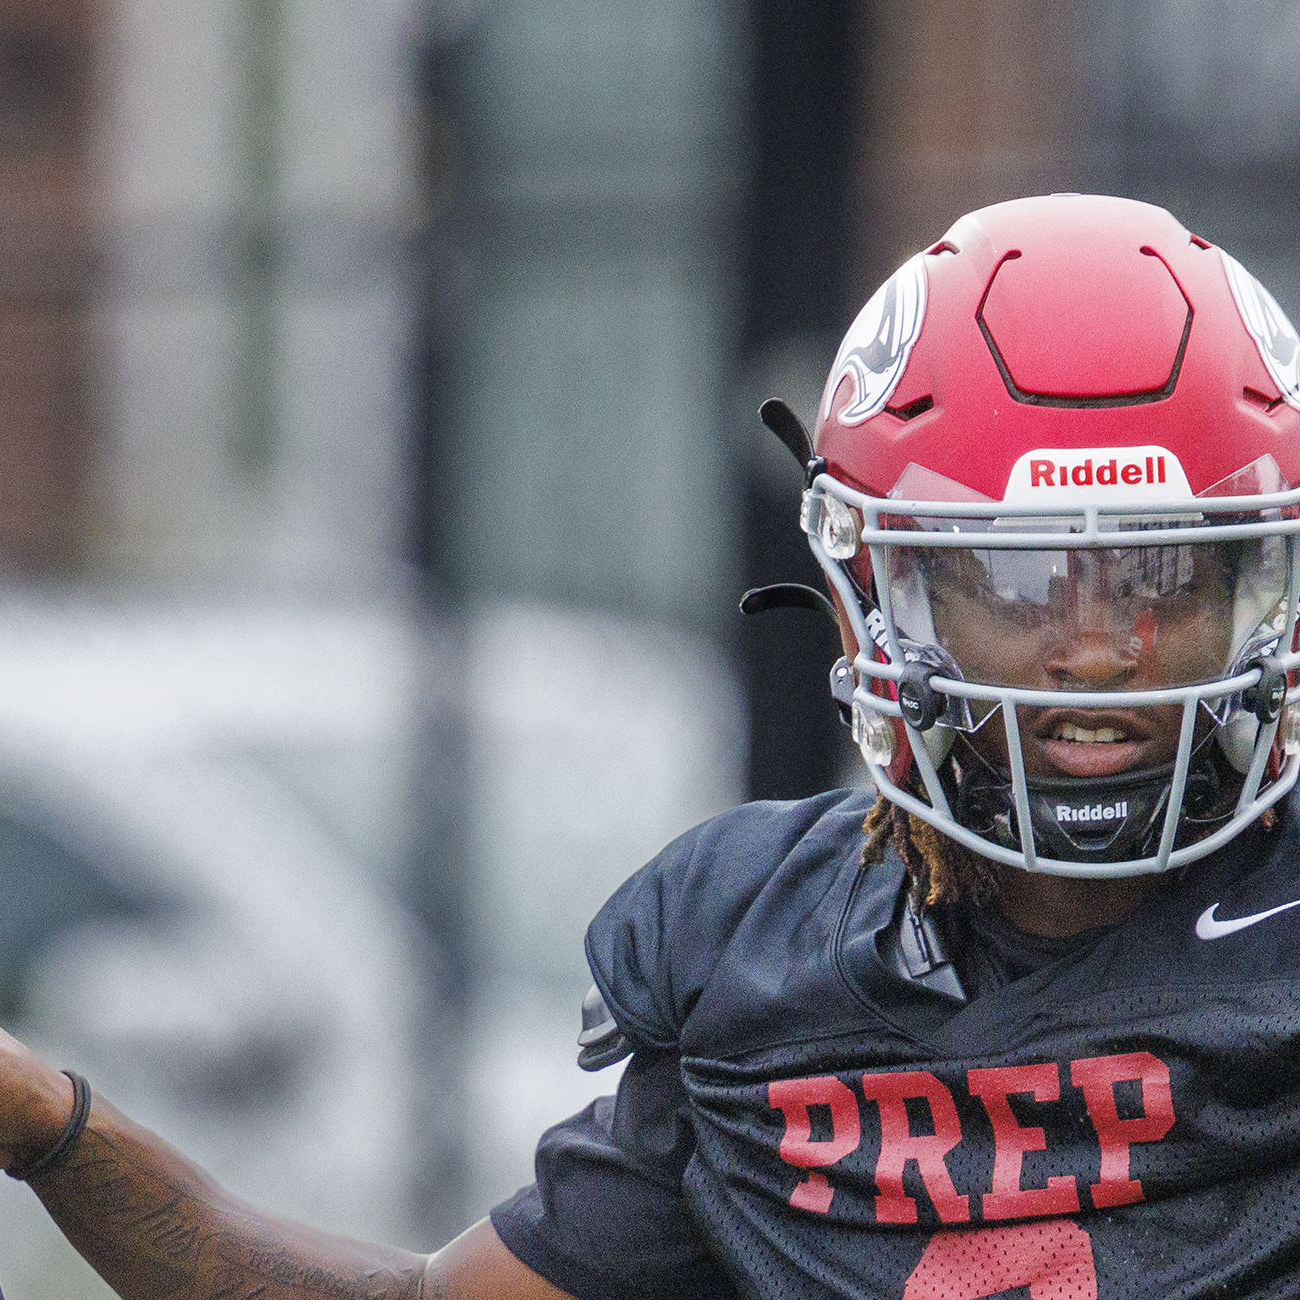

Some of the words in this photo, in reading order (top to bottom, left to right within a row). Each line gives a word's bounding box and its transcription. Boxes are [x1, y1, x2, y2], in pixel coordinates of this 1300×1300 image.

[1029, 455, 1167, 487] Riddell
[1056, 801, 1128, 822] Riddell
[767, 1051, 1177, 1224] PREP
